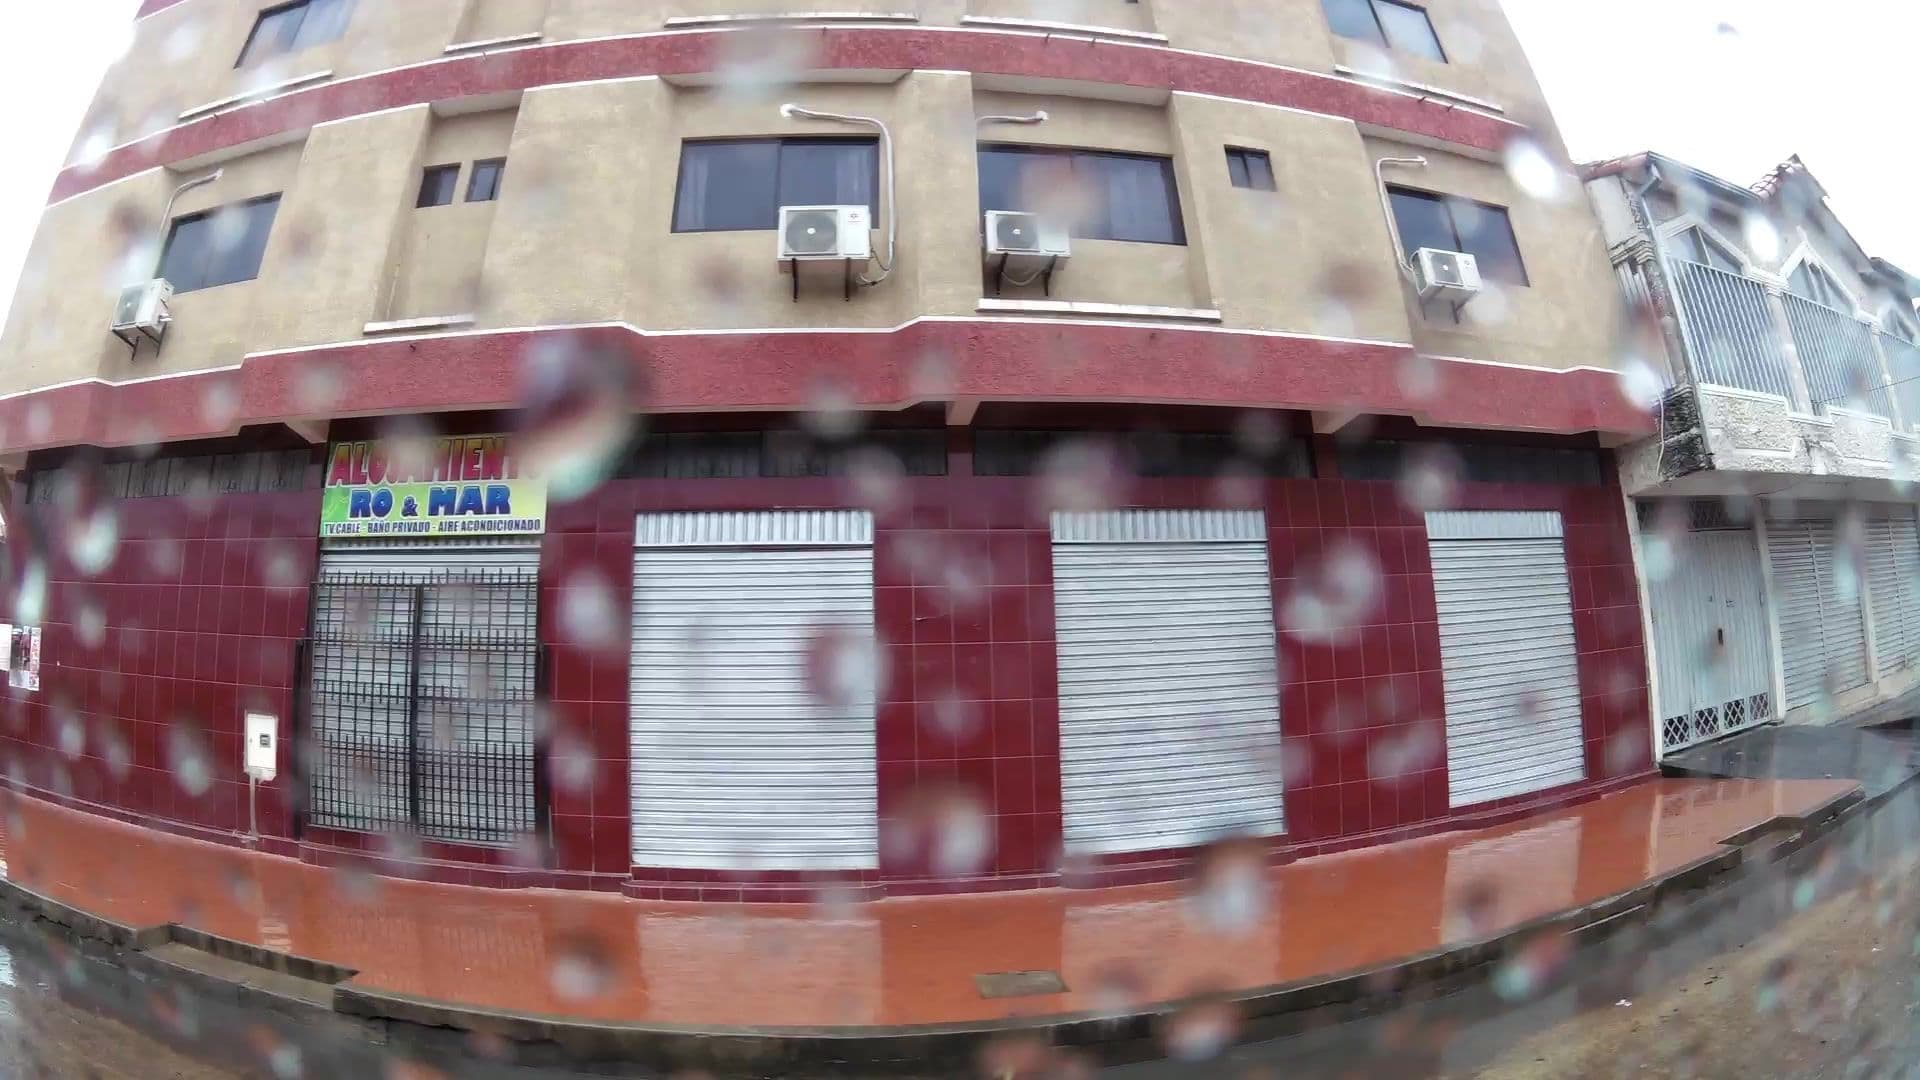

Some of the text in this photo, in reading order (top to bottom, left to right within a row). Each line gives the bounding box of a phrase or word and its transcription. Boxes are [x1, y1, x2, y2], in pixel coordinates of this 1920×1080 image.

[327, 436, 543, 487] ALOJAMIEN
[349, 484, 511, 518] RO & MAR
[367, 521, 391, 534] BAÑO
[392, 521, 430, 533] PRIVADO
[438, 520, 460, 533] AIRE
[461, 518, 542, 532] ACONDICIONADO
